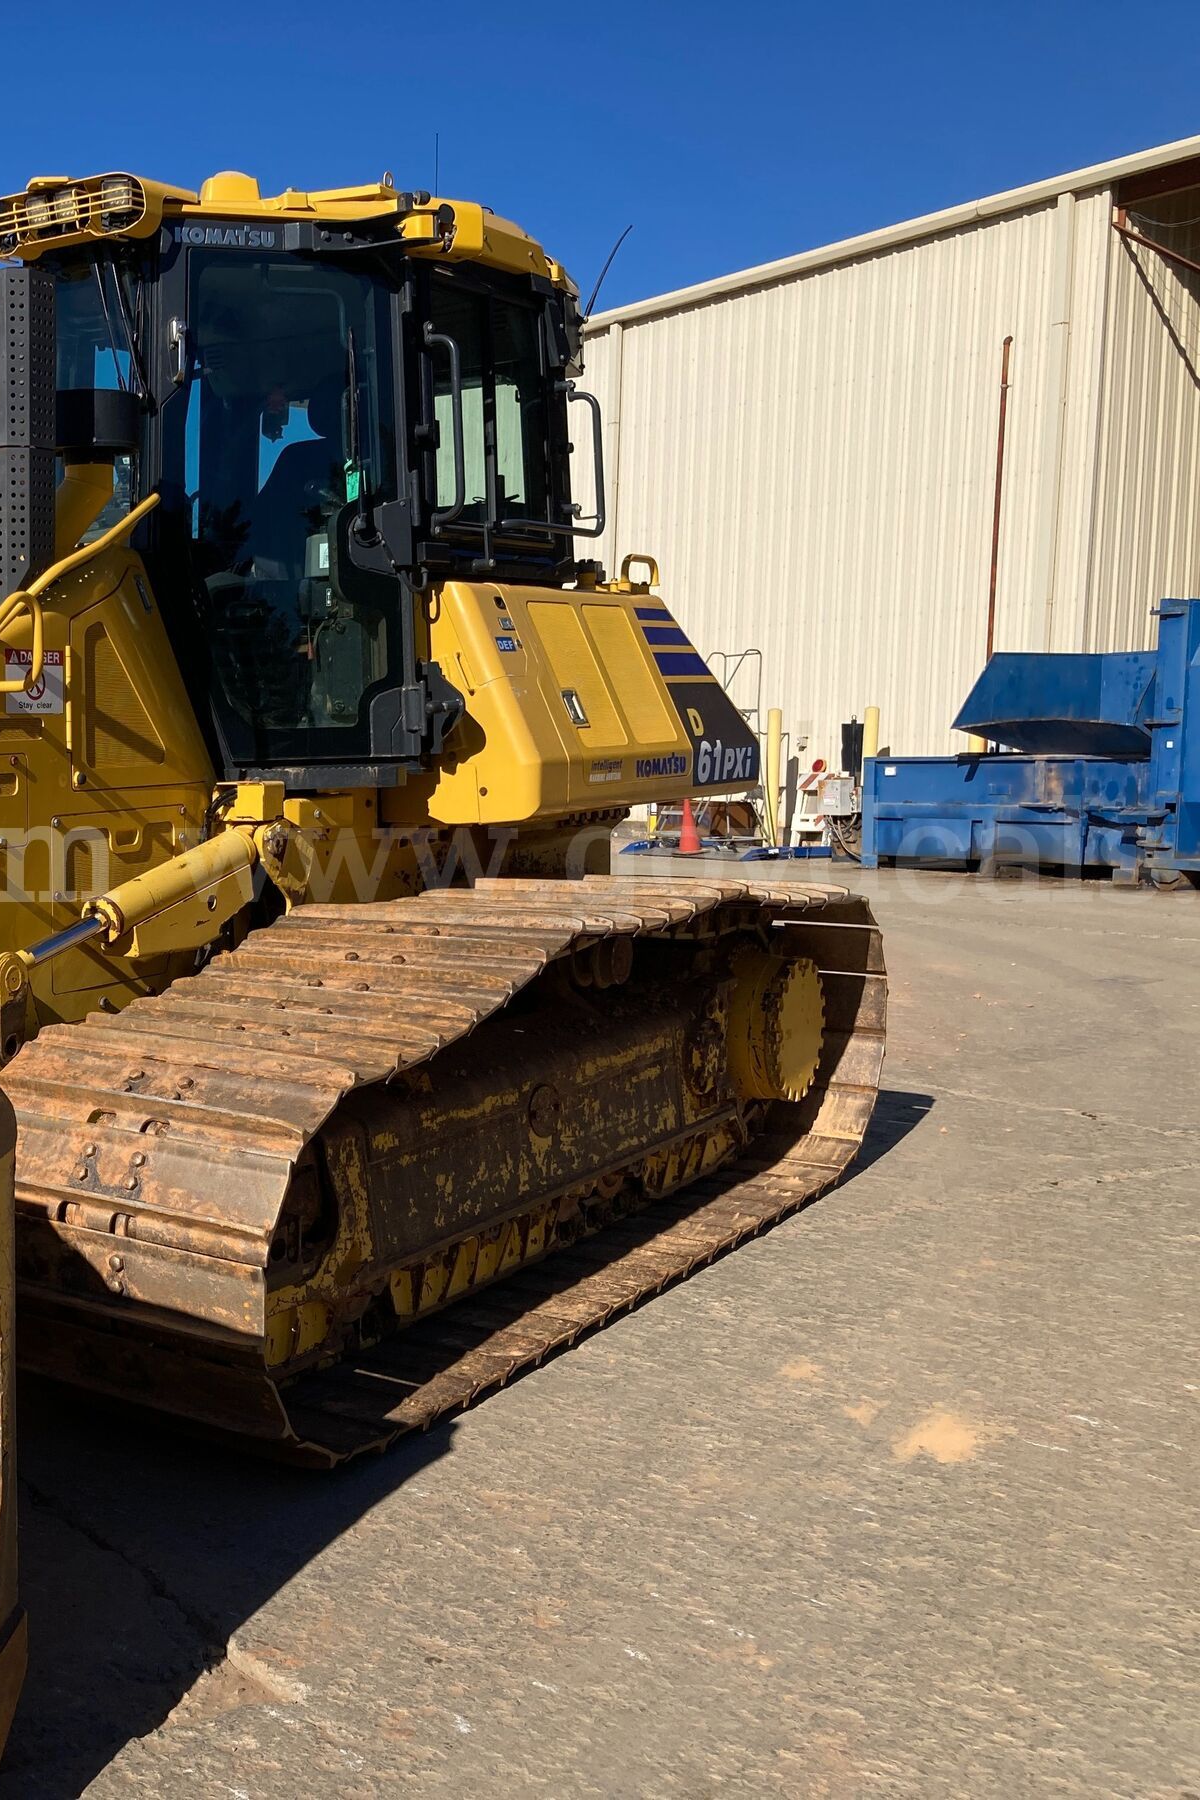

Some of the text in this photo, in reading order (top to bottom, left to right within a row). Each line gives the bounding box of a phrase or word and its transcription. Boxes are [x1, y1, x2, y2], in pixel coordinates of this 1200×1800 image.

[174, 225, 275, 248] KOMATSU
[497, 640, 515, 650] DEF
[20, 651, 60, 664] DAGER
[18, 701, 53, 710] Stay clear
[686, 708, 704, 737] D
[636, 752, 687, 778] KOMATSU
